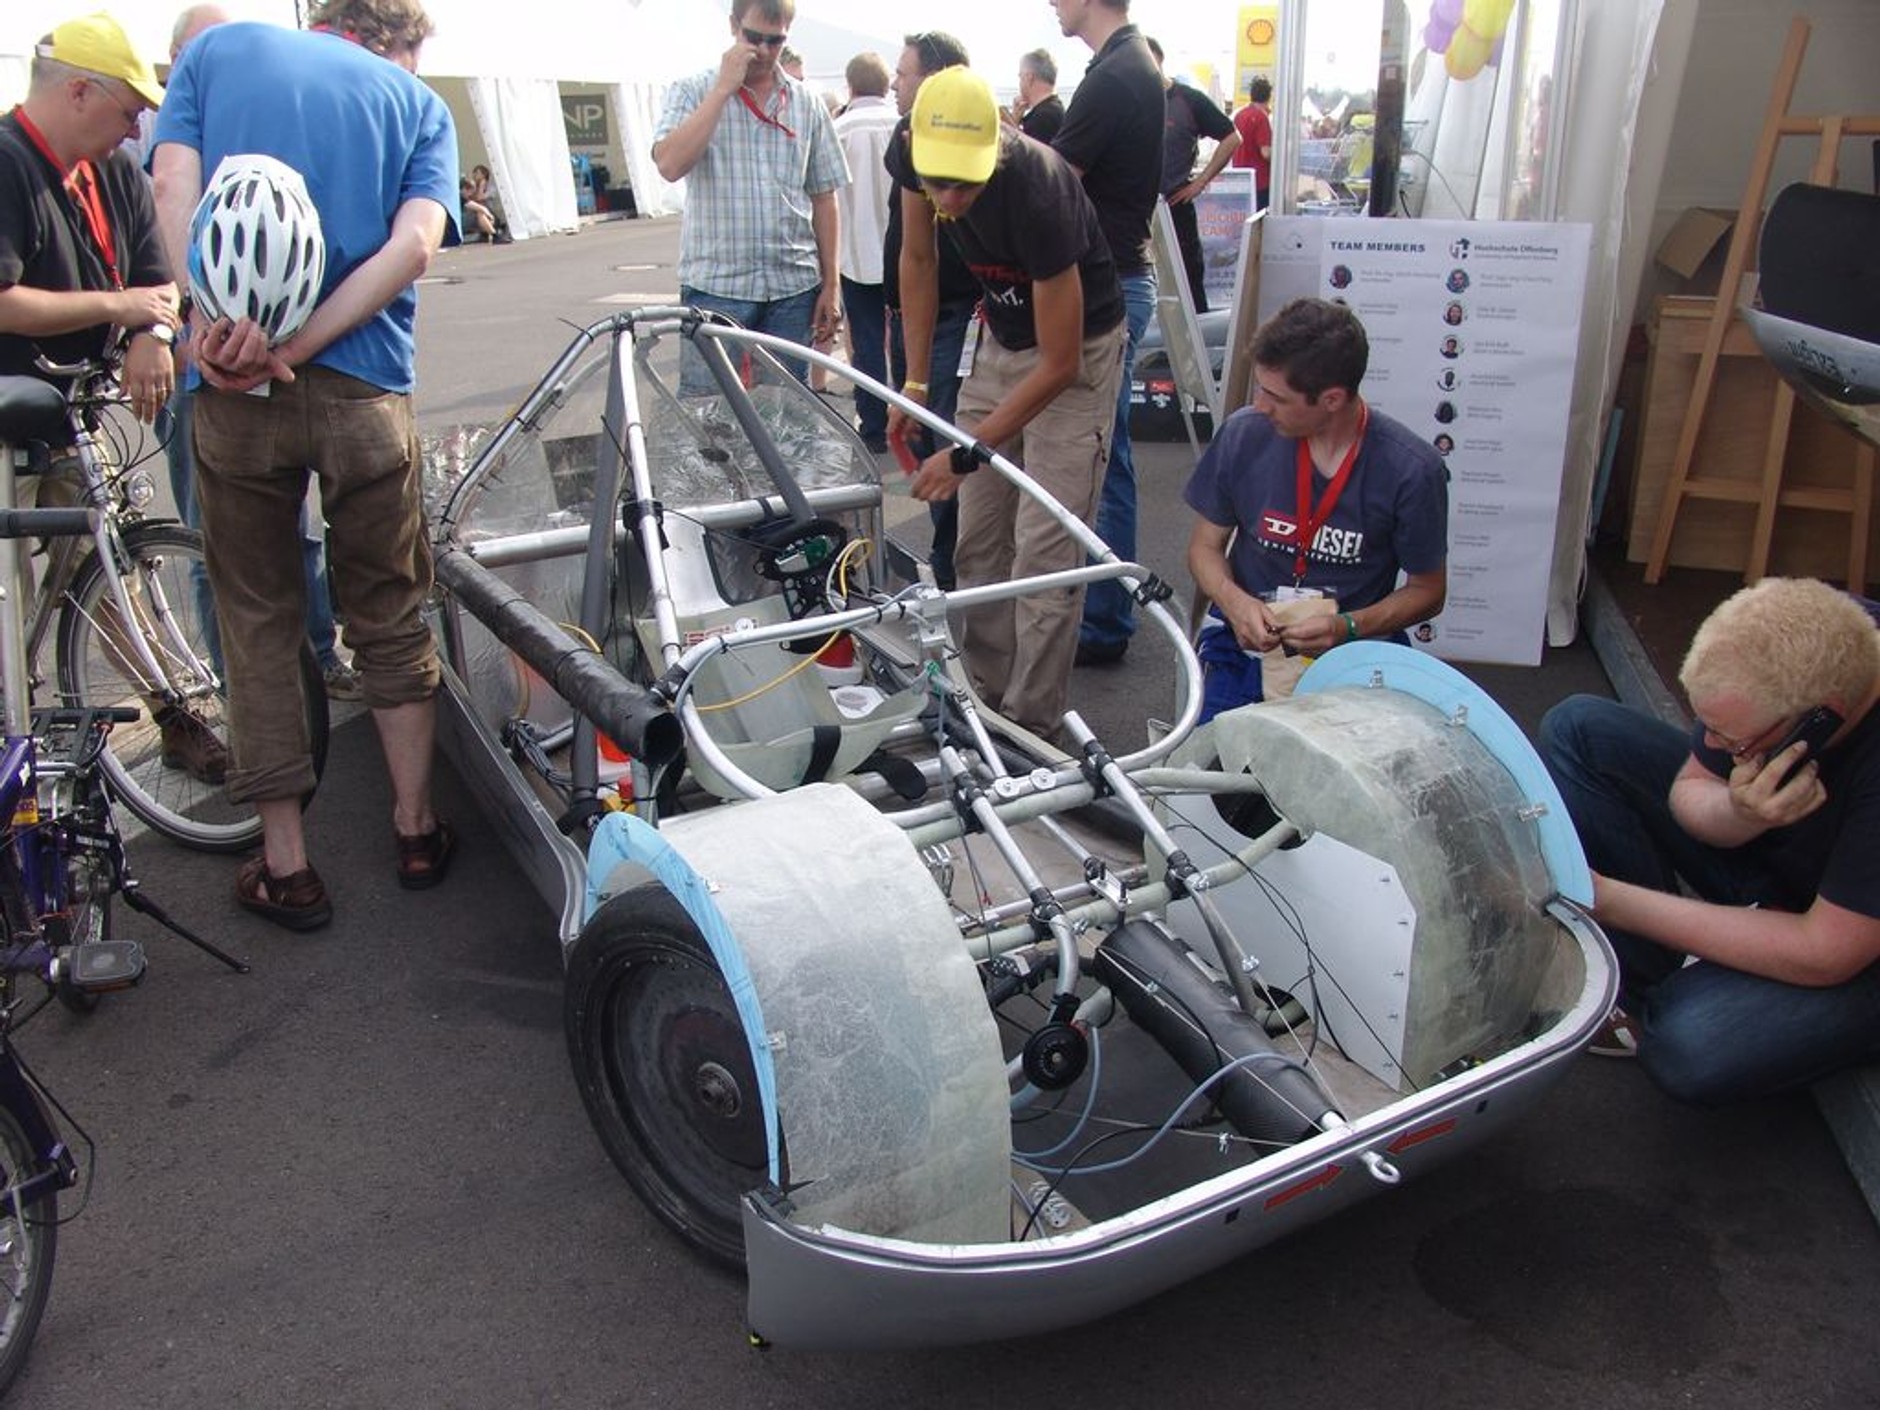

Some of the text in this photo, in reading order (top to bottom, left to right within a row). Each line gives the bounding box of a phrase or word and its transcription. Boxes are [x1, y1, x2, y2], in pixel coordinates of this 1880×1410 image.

[1331, 241, 1426, 253] TEAM MEMBERS
[1312, 525, 1363, 558] IESEL
